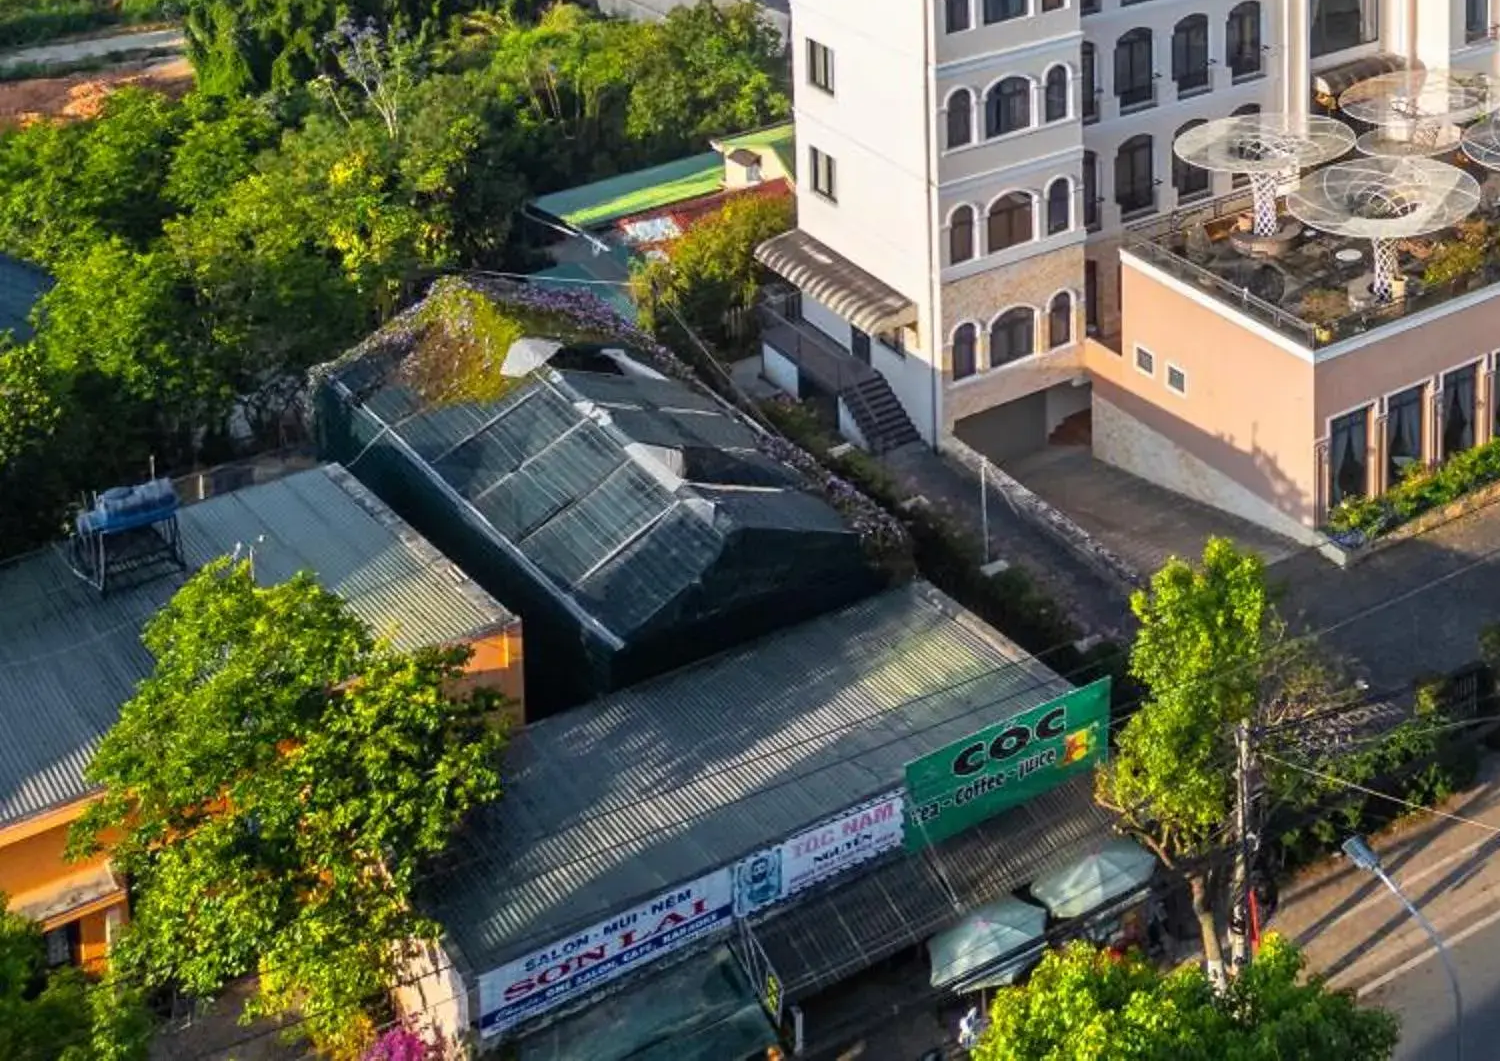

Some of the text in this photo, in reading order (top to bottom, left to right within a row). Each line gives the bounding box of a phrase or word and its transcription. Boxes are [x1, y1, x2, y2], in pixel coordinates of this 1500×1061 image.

[955, 772, 1006, 806] Coffee
[841, 802, 894, 834] NAM
[618, 898, 708, 948] LAI
[525, 933, 589, 972] SALON
